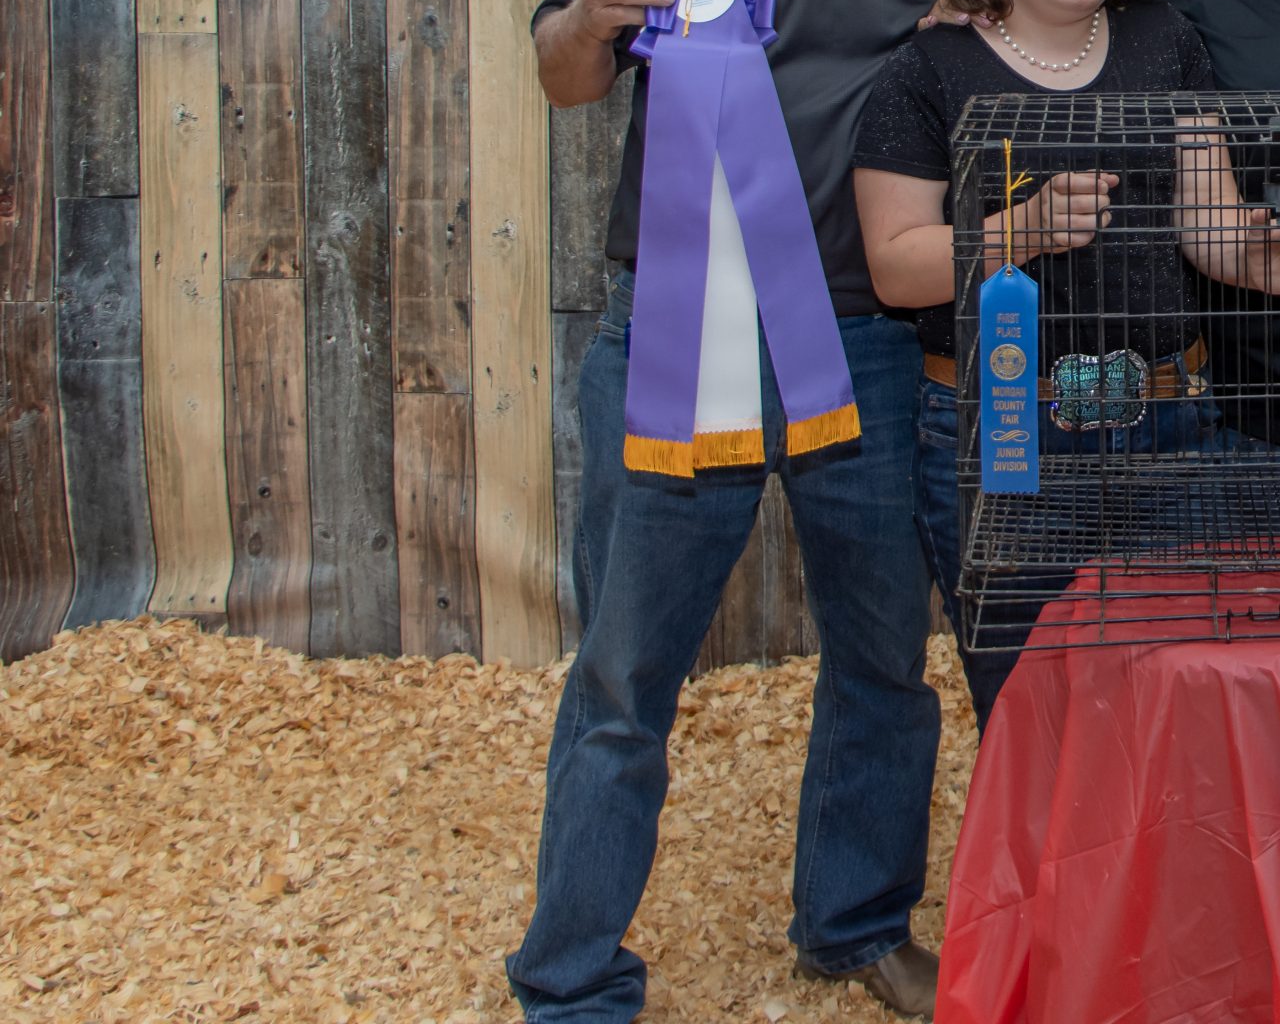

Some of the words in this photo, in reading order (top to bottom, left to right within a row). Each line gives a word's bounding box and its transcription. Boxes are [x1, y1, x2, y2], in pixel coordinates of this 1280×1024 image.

[997, 313, 1020, 324] FIRST
[996, 327, 1022, 338] PLACE
[1079, 364, 1121, 374] MORAN
[1073, 371, 1104, 382] COUNT
[992, 386, 1027, 397] MORGAN
[993, 400, 1026, 411] COUNTY
[1001, 414, 1019, 425] FAIR
[995, 447, 1025, 458] JUNIOR
[993, 461, 1028, 472] DIVISION
